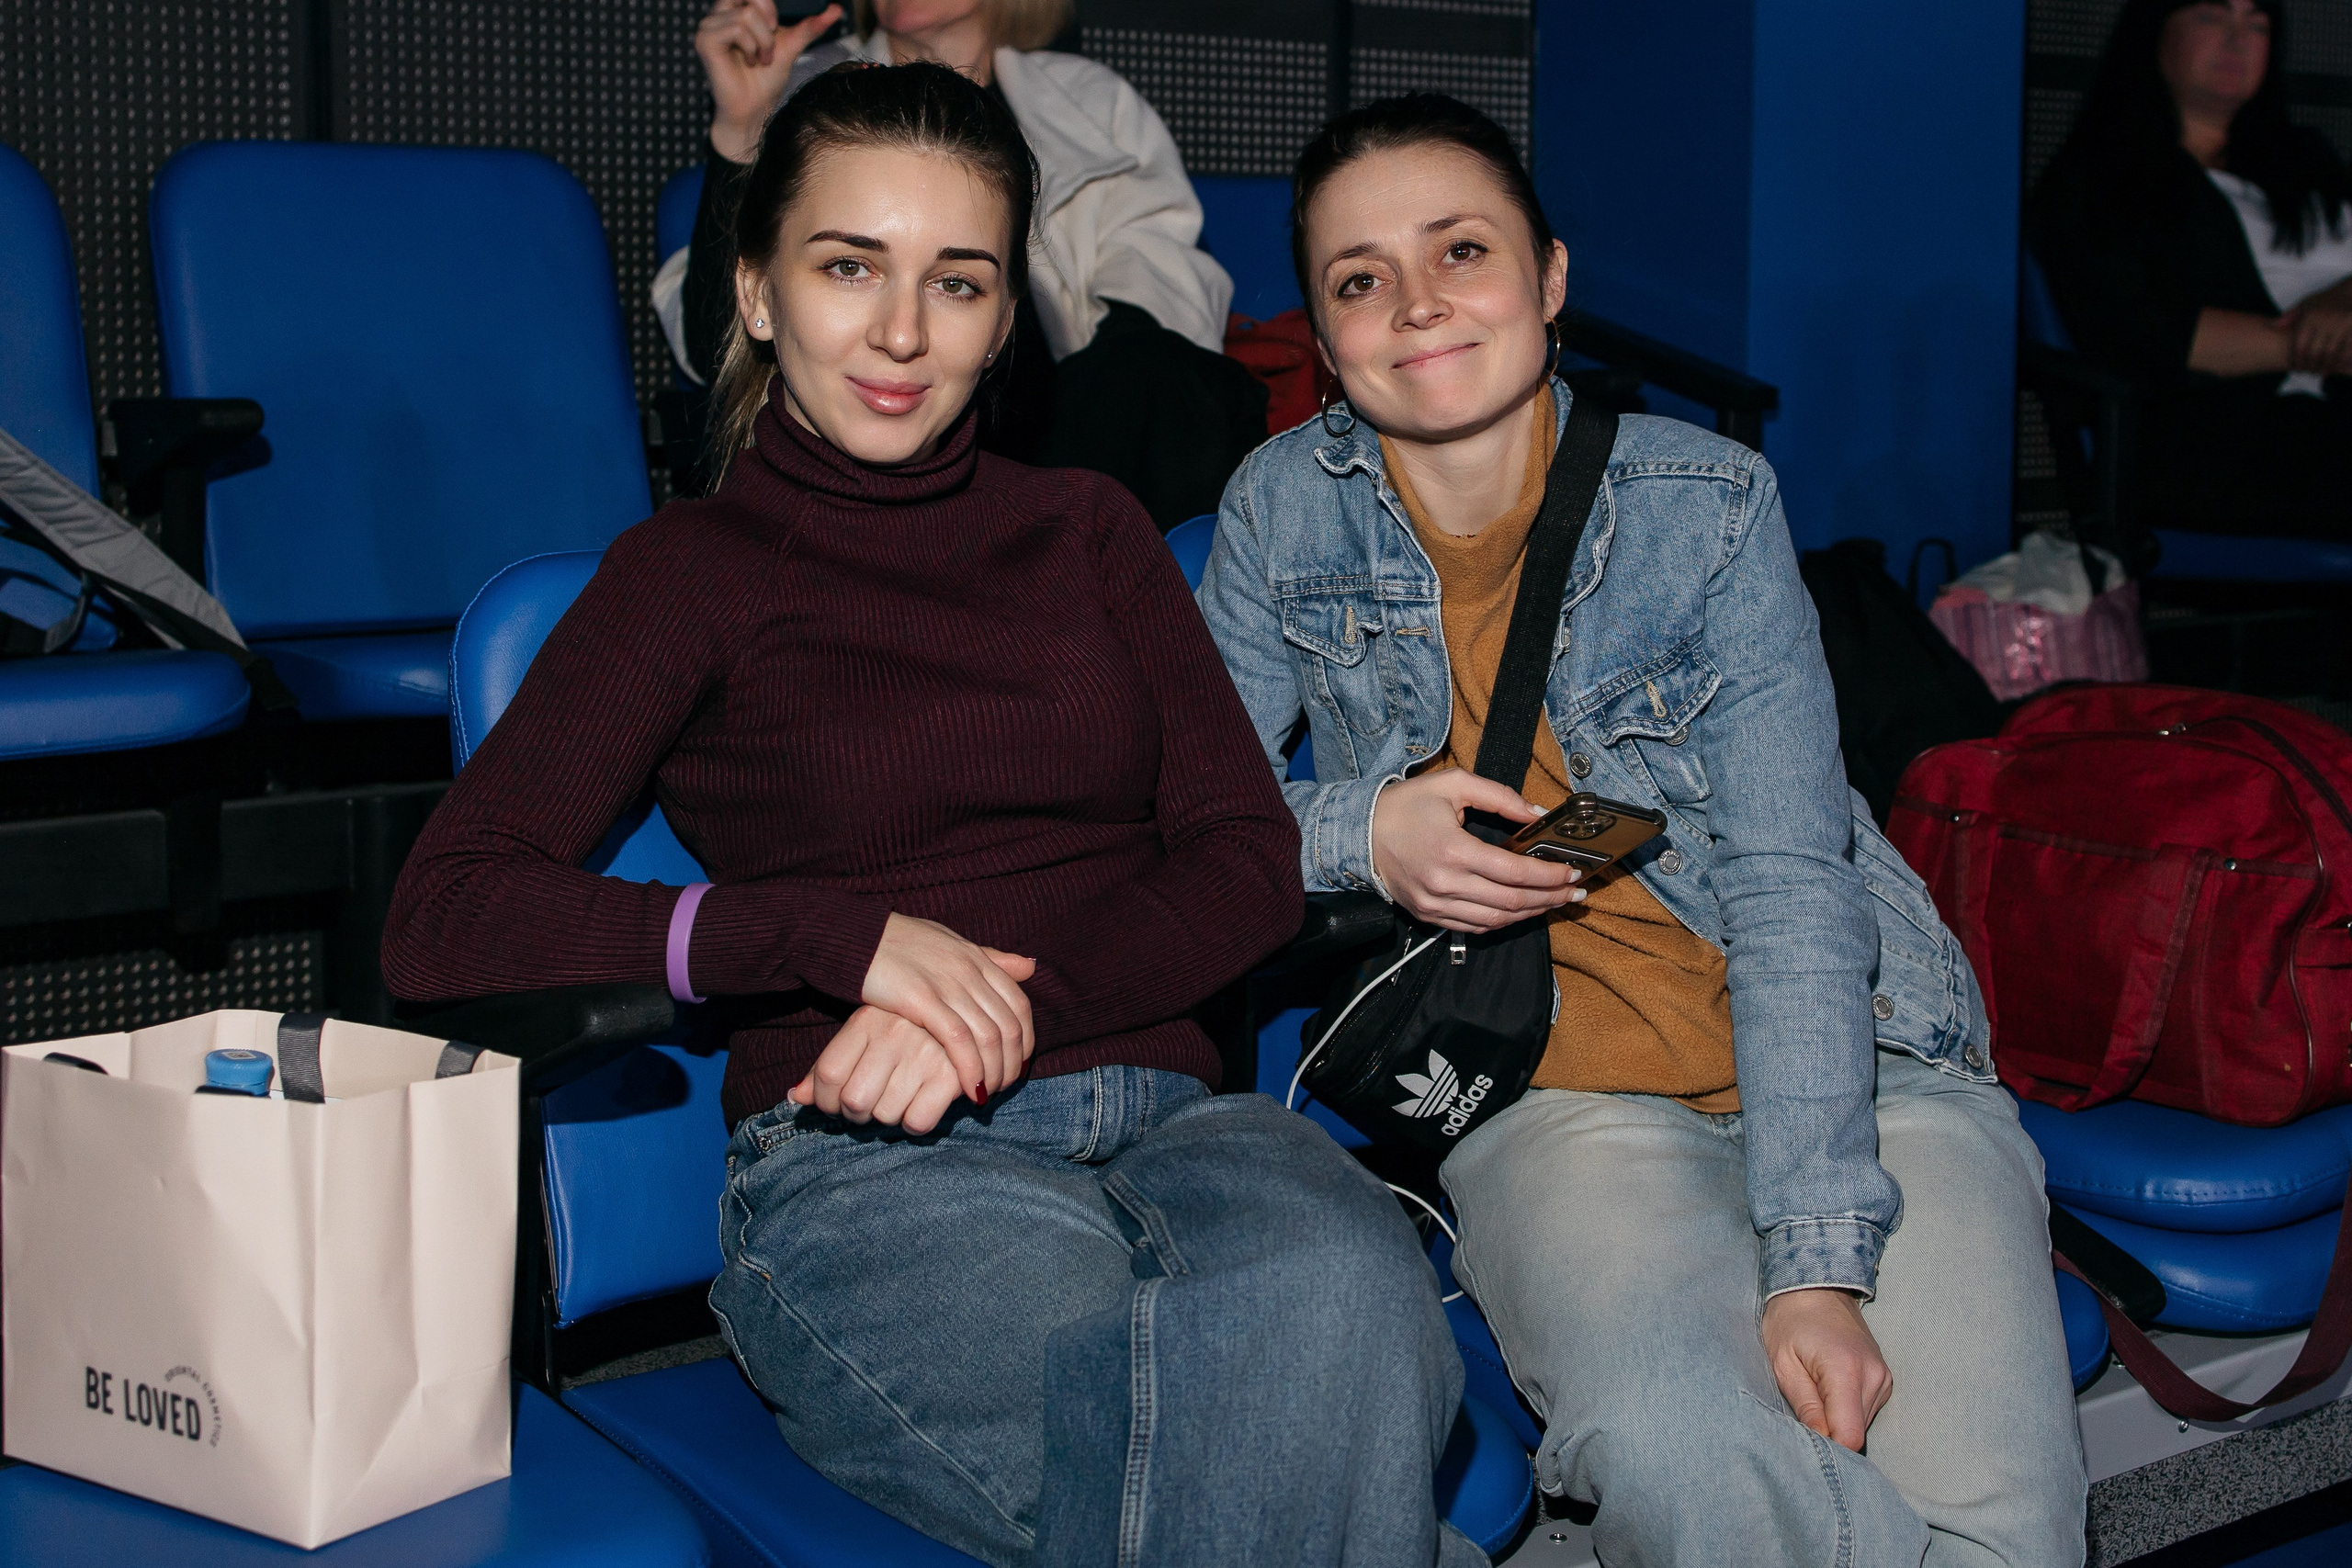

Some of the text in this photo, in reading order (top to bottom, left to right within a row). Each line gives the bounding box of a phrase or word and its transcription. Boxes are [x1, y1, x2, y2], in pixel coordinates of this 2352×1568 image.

[1441, 1074, 1493, 1136] adidas
[85, 1366, 201, 1441] BE LOVED
